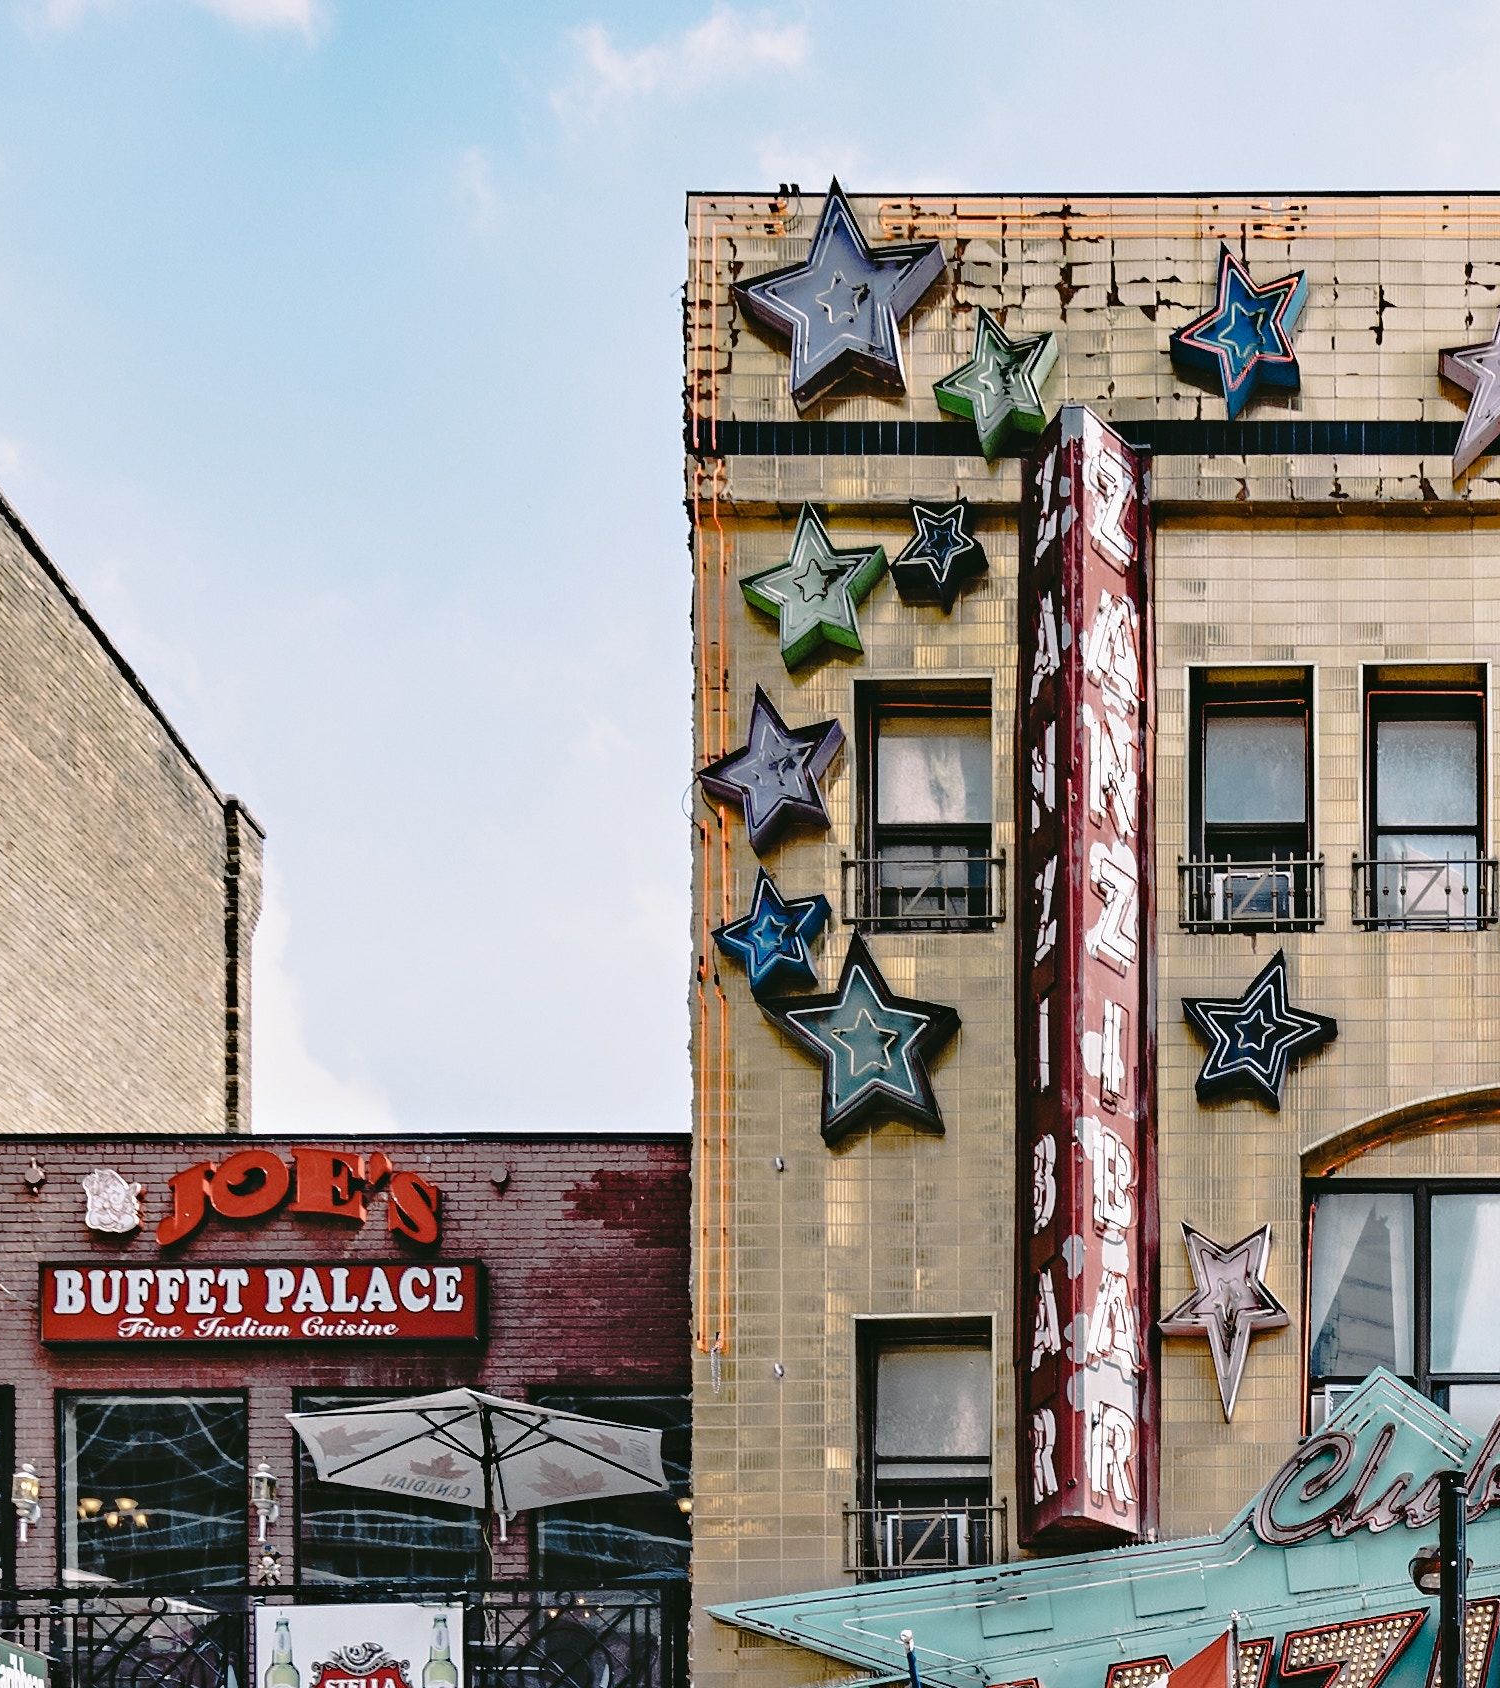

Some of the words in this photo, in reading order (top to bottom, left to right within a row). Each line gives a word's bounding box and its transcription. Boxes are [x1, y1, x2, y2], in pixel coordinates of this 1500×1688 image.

[1083, 448, 1143, 1512] ZANZIBAR
[156, 1148, 443, 1245] JOE'S
[53, 1268, 250, 1314] BUFFET
[264, 1267, 464, 1314] PALACE
[117, 1317, 185, 1338] Fine
[198, 1317, 291, 1338] Indian
[301, 1317, 400, 1337] Cuisine
